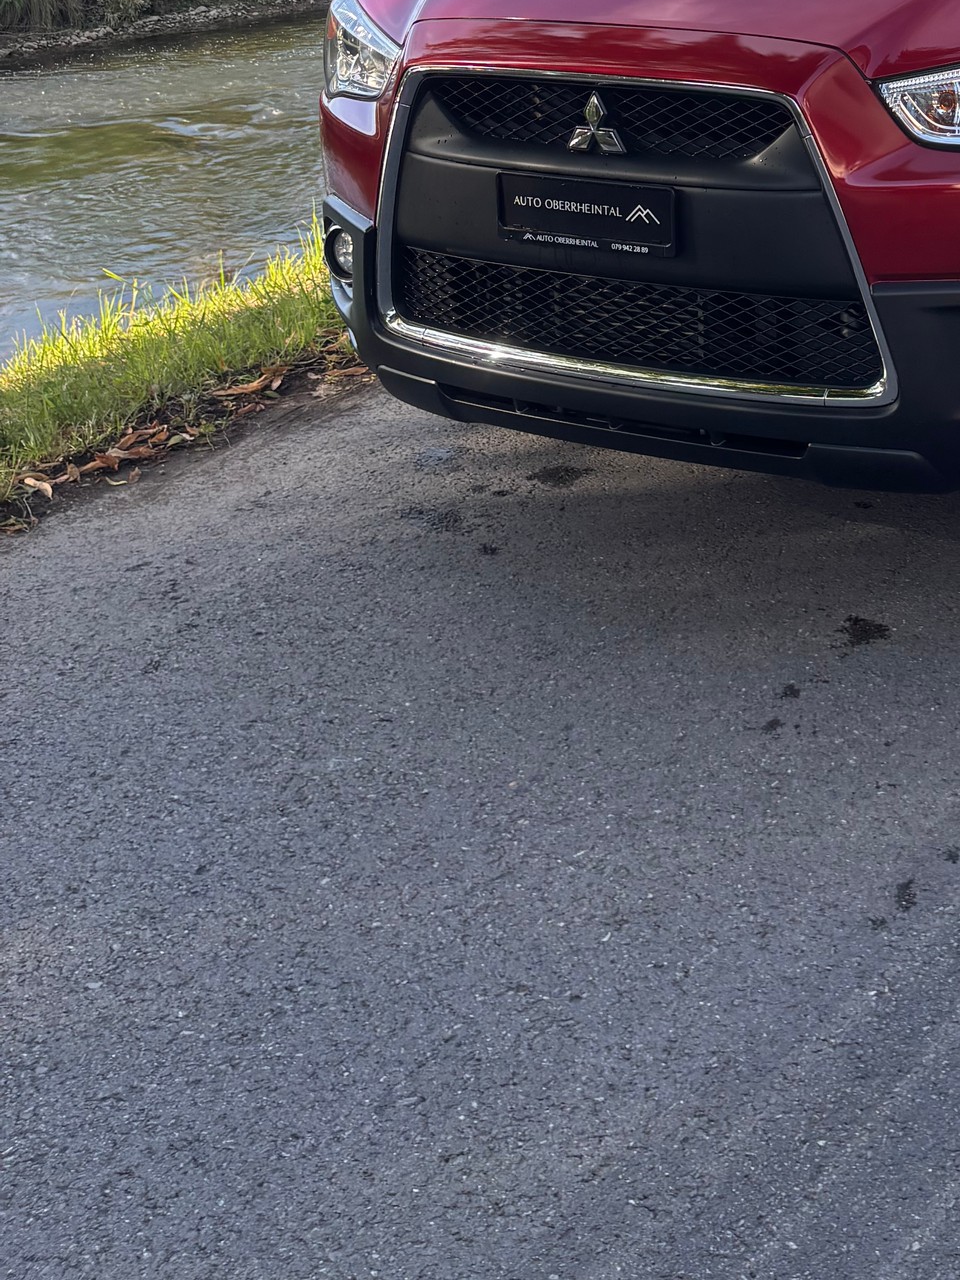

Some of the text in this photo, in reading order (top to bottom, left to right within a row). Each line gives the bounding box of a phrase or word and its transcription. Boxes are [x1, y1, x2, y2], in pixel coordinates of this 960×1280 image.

[514, 195, 623, 217] AUTO OBERRHEINTAL
[536, 234, 599, 248] AUTO OBERRHEINTAL
[611, 243, 622, 251] 079
